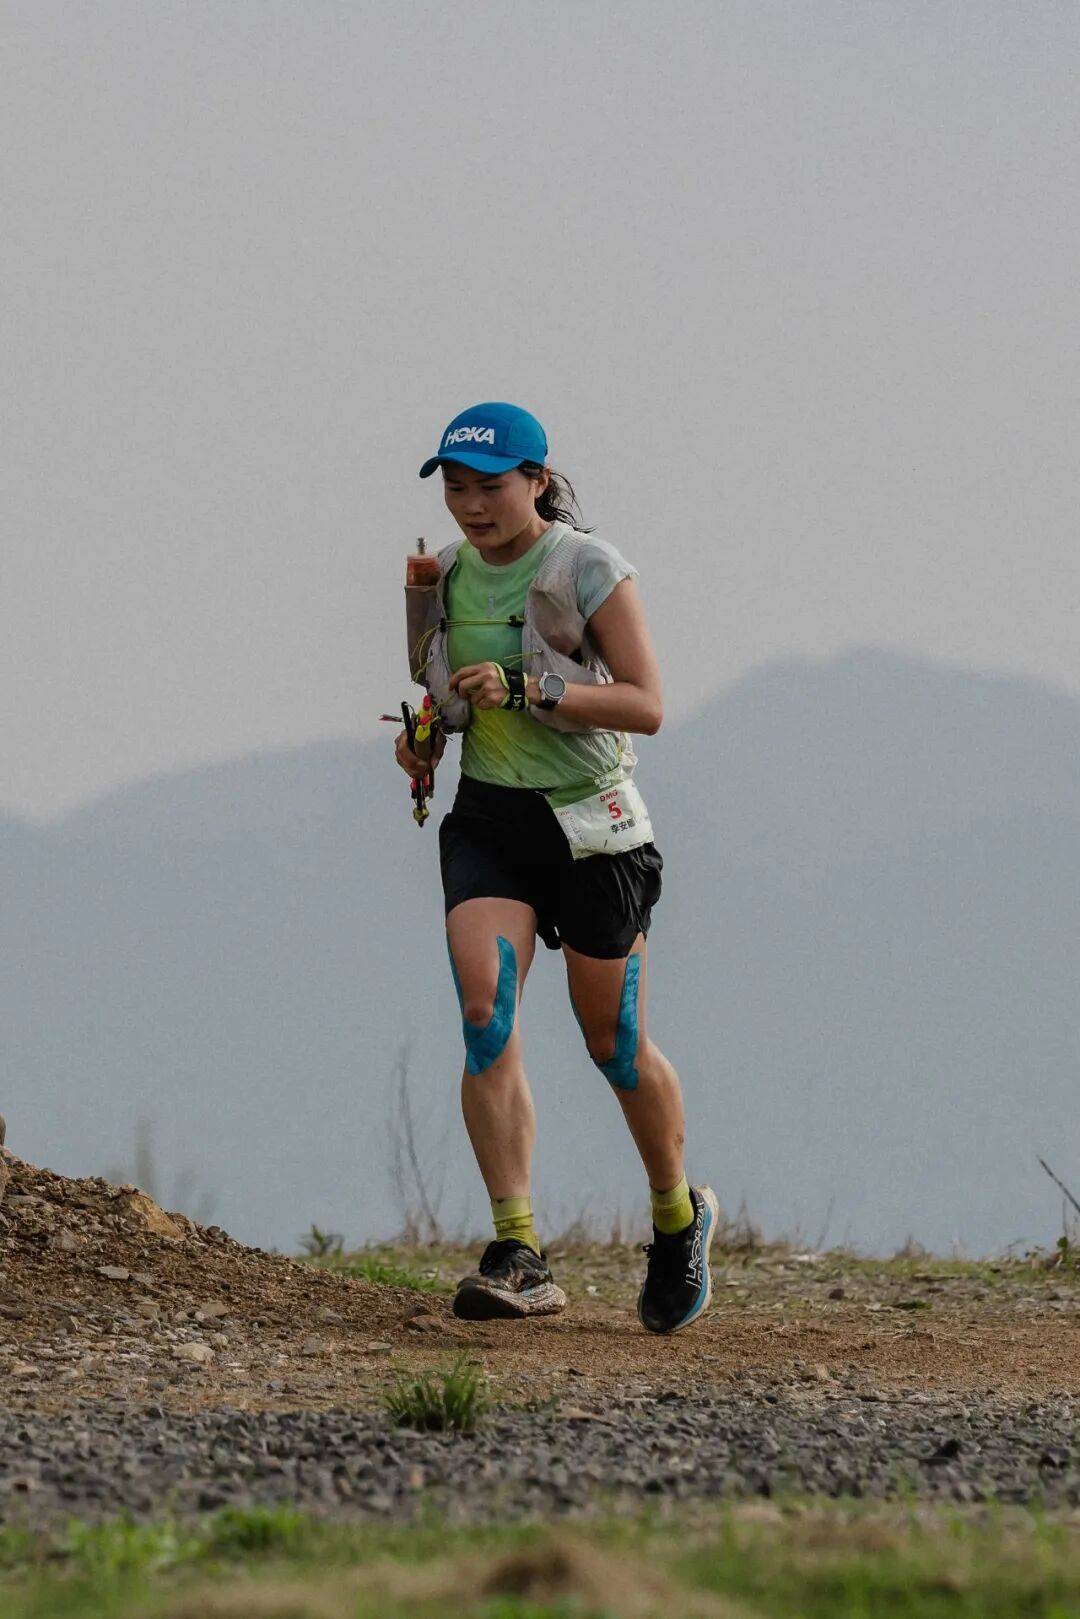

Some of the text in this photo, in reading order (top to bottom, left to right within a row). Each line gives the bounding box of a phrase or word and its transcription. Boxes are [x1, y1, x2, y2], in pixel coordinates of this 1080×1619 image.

[445, 427, 495, 448] HOKA
[608, 801, 622, 820] 5
[610, 817, 636, 834] 李安
